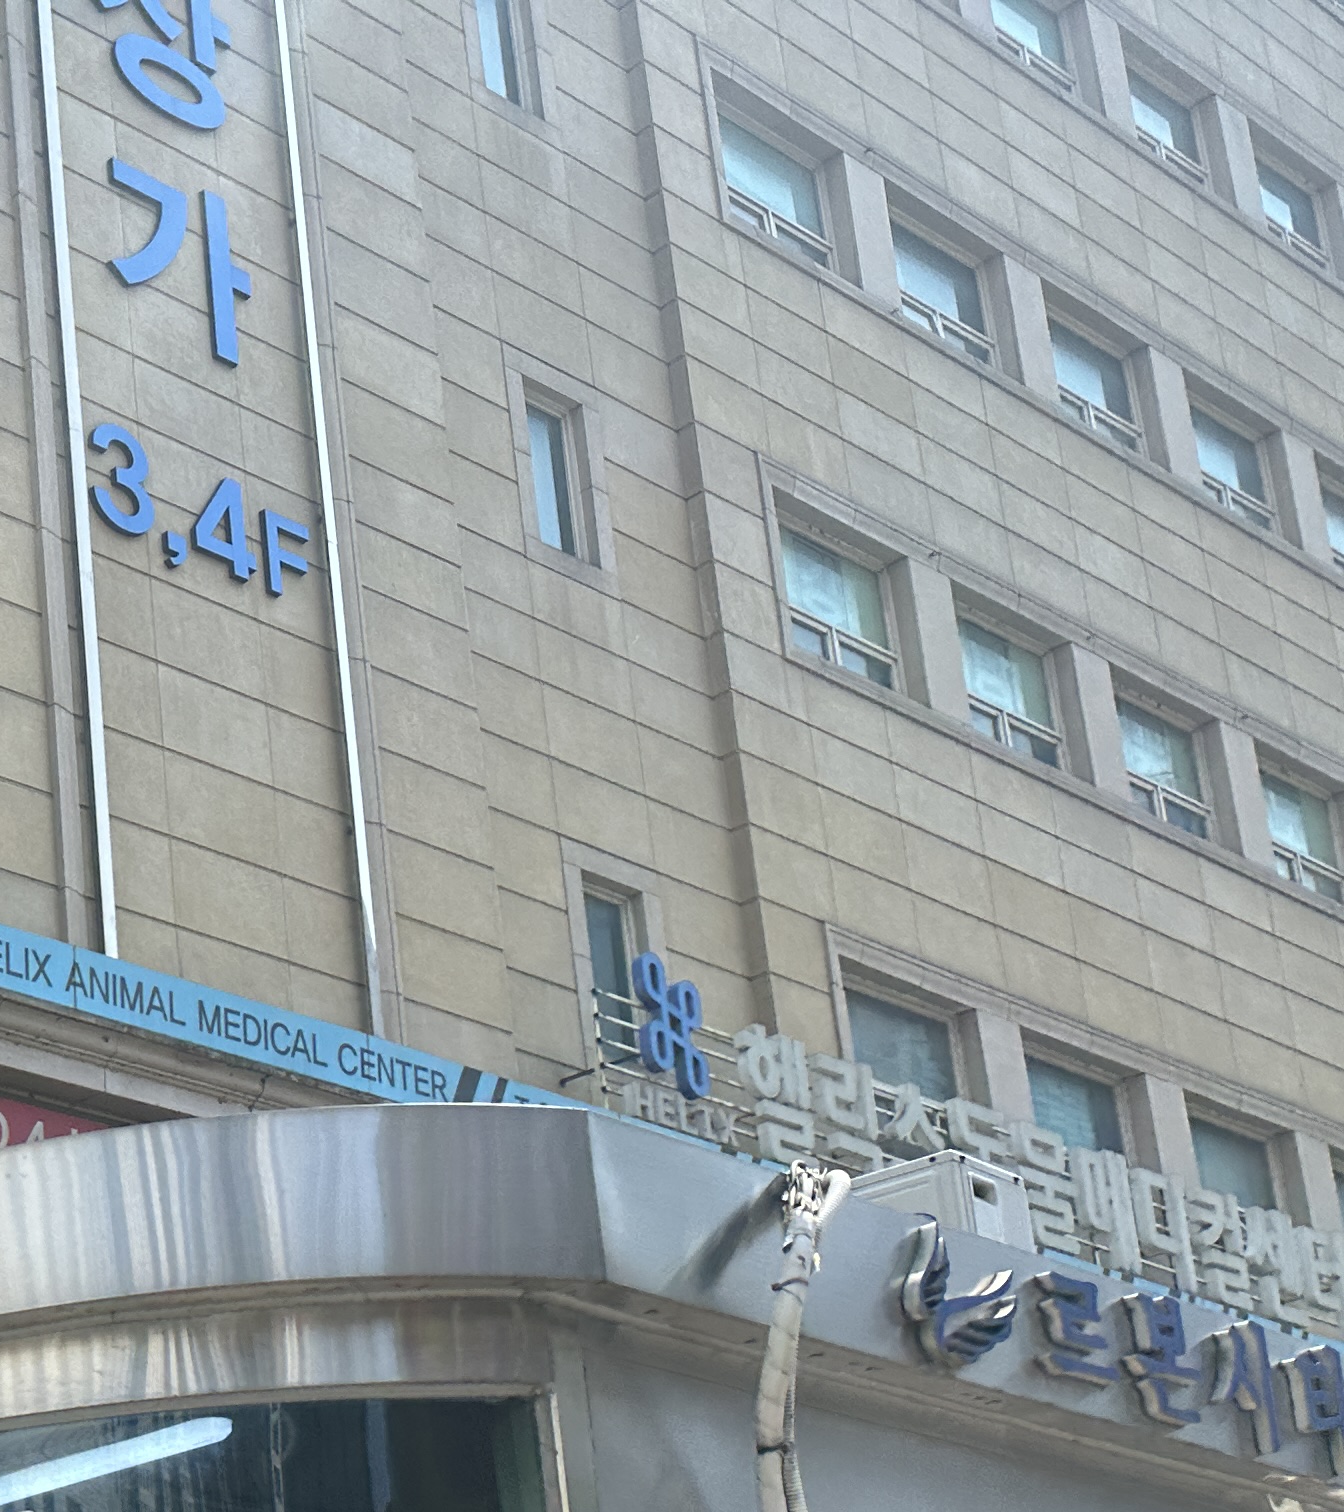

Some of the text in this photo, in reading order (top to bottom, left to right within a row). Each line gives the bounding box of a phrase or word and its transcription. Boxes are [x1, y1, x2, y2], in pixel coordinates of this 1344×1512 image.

[88, 423, 310, 597] 3,4F
[65, 959, 186, 1027] ANIMAL
[198, 1000, 328, 1067] MEDICAL
[337, 1042, 448, 1100] CENTER
